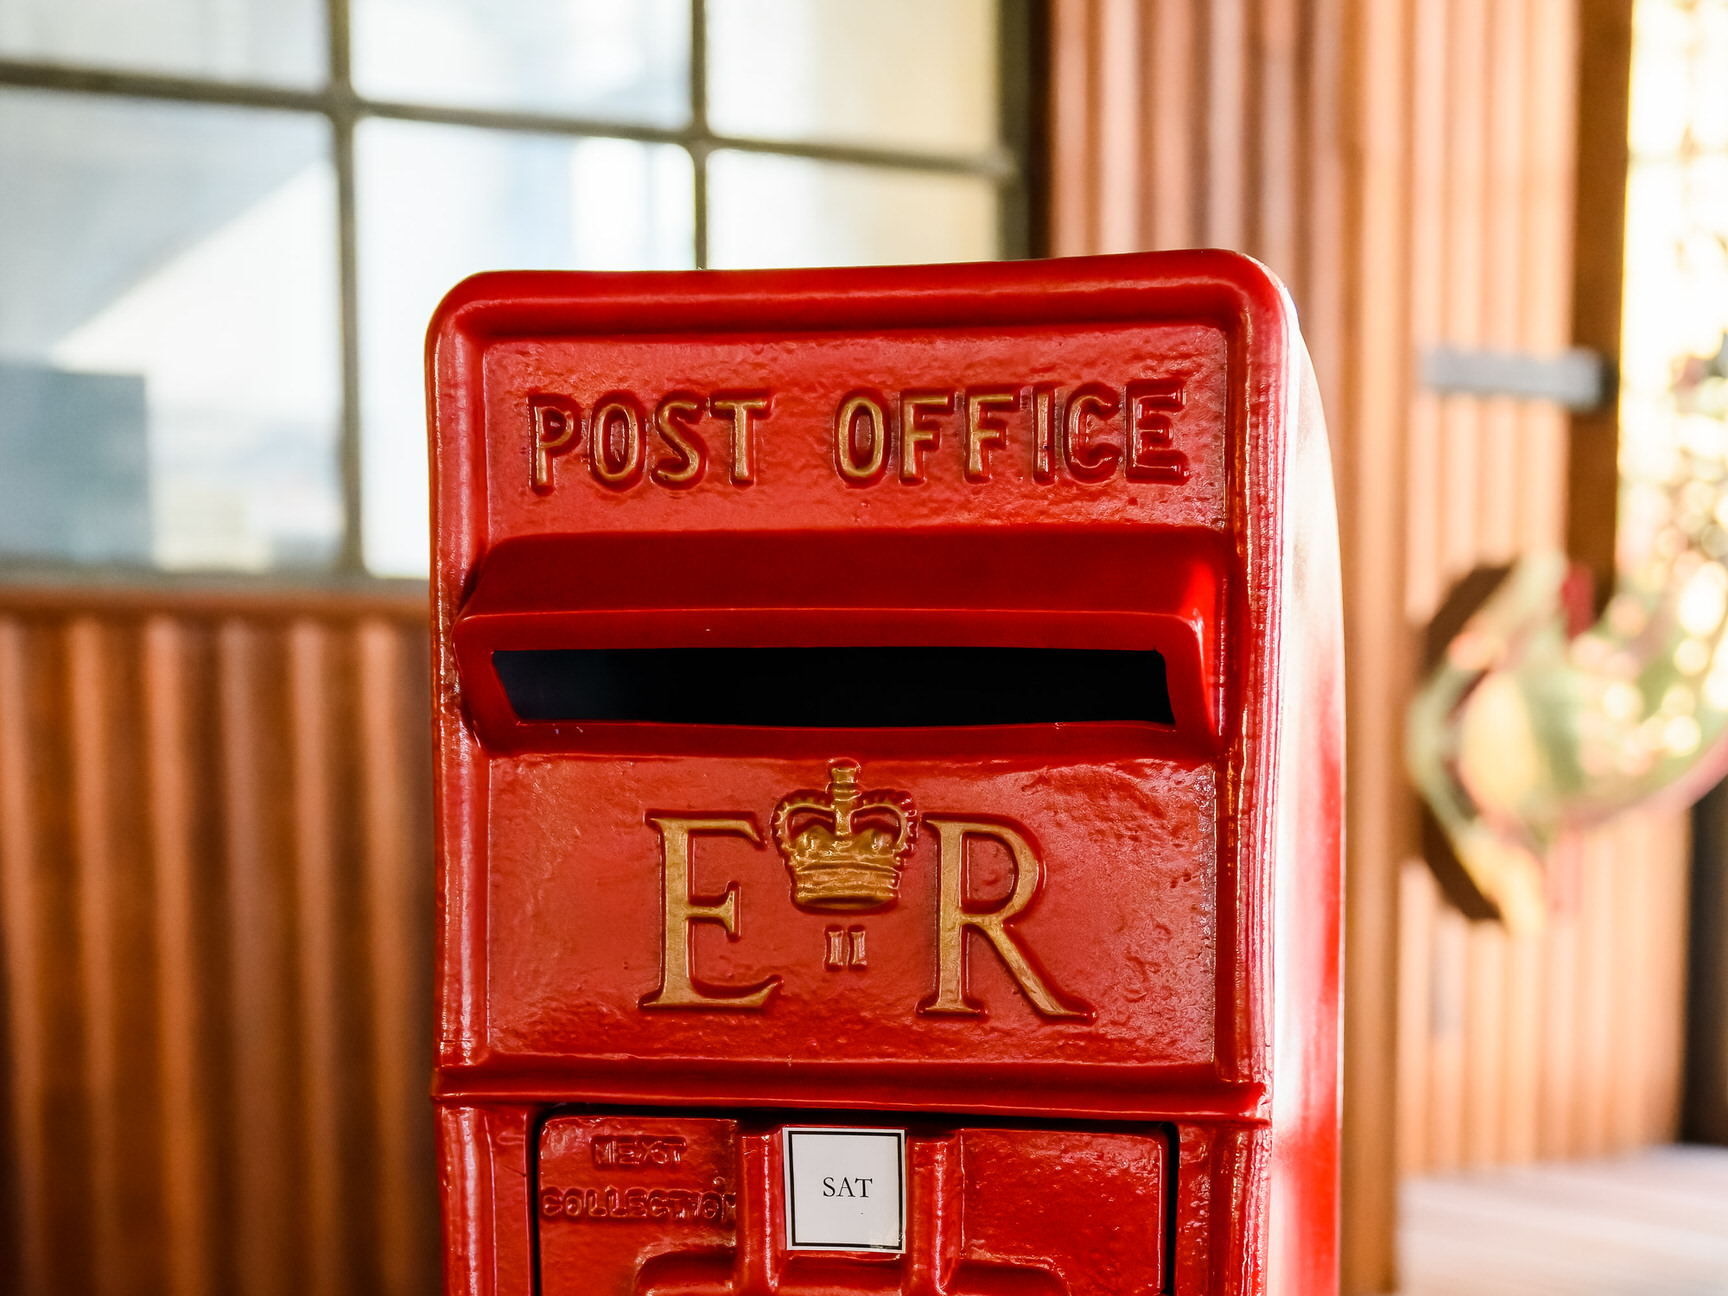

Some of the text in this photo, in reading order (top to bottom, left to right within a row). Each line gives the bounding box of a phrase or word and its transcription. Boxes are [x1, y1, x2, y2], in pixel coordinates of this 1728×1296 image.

[527, 379, 1194, 496] POST OFFICE
[637, 812, 1098, 1024] E R
[823, 925, 868, 971] II
[591, 1135, 688, 1168] NEXT
[822, 1176, 873, 1198] SAT
